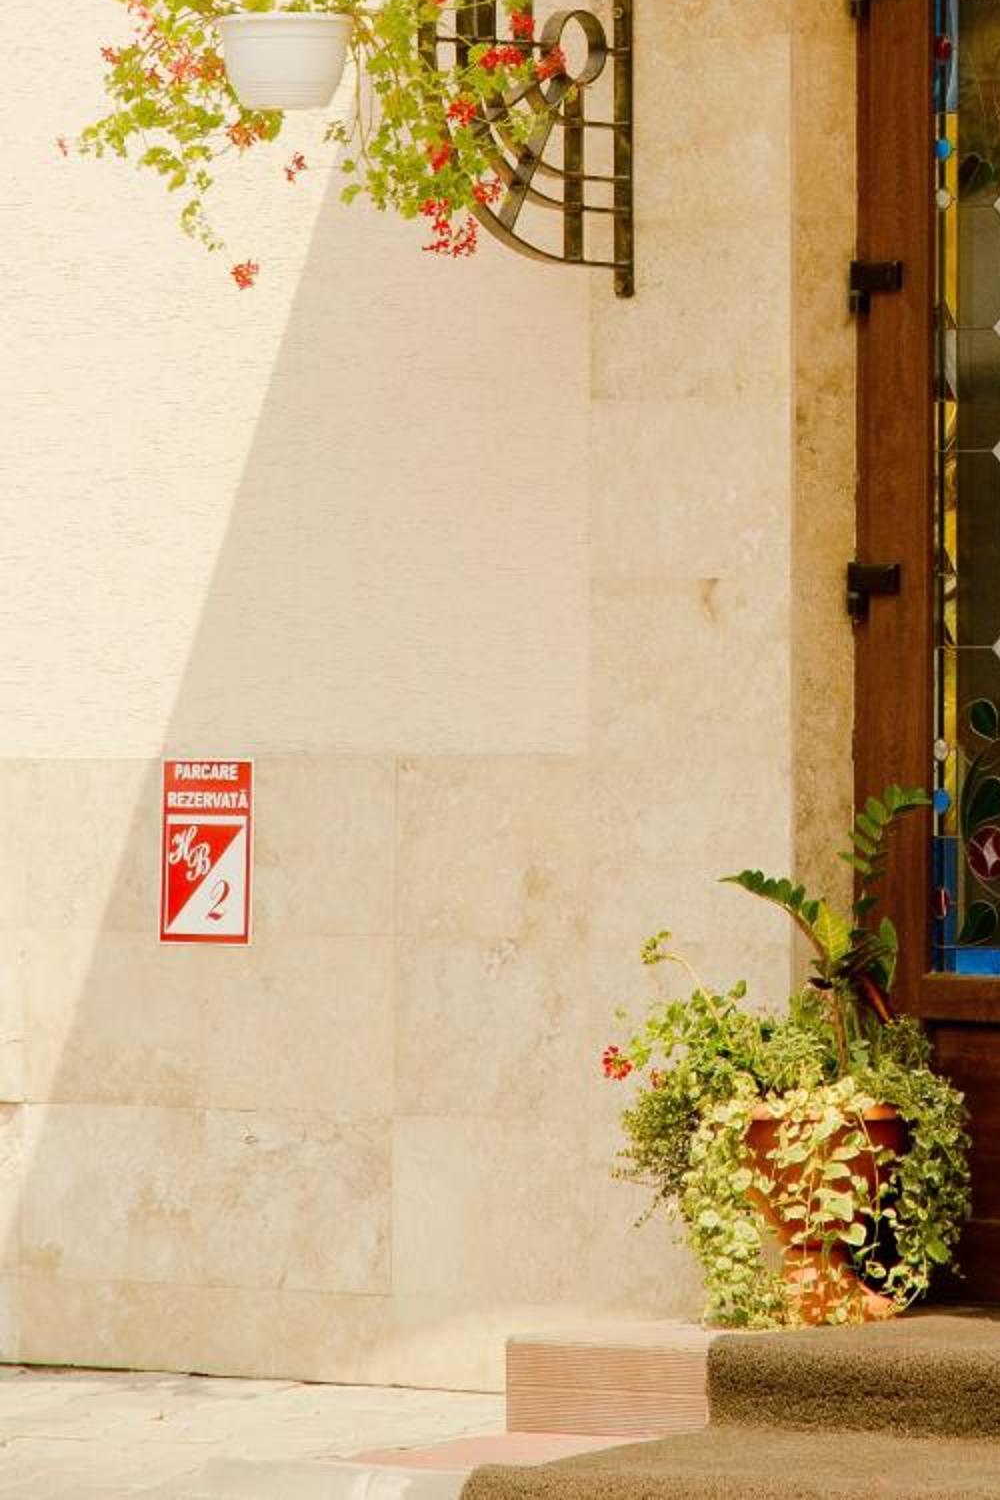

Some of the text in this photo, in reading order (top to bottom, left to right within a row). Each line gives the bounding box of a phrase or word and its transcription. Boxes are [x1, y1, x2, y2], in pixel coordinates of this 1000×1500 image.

[175, 763, 239, 781] PARCARE
[167, 788, 249, 809] REZERVATĂ
[206, 879, 231, 921] 2
